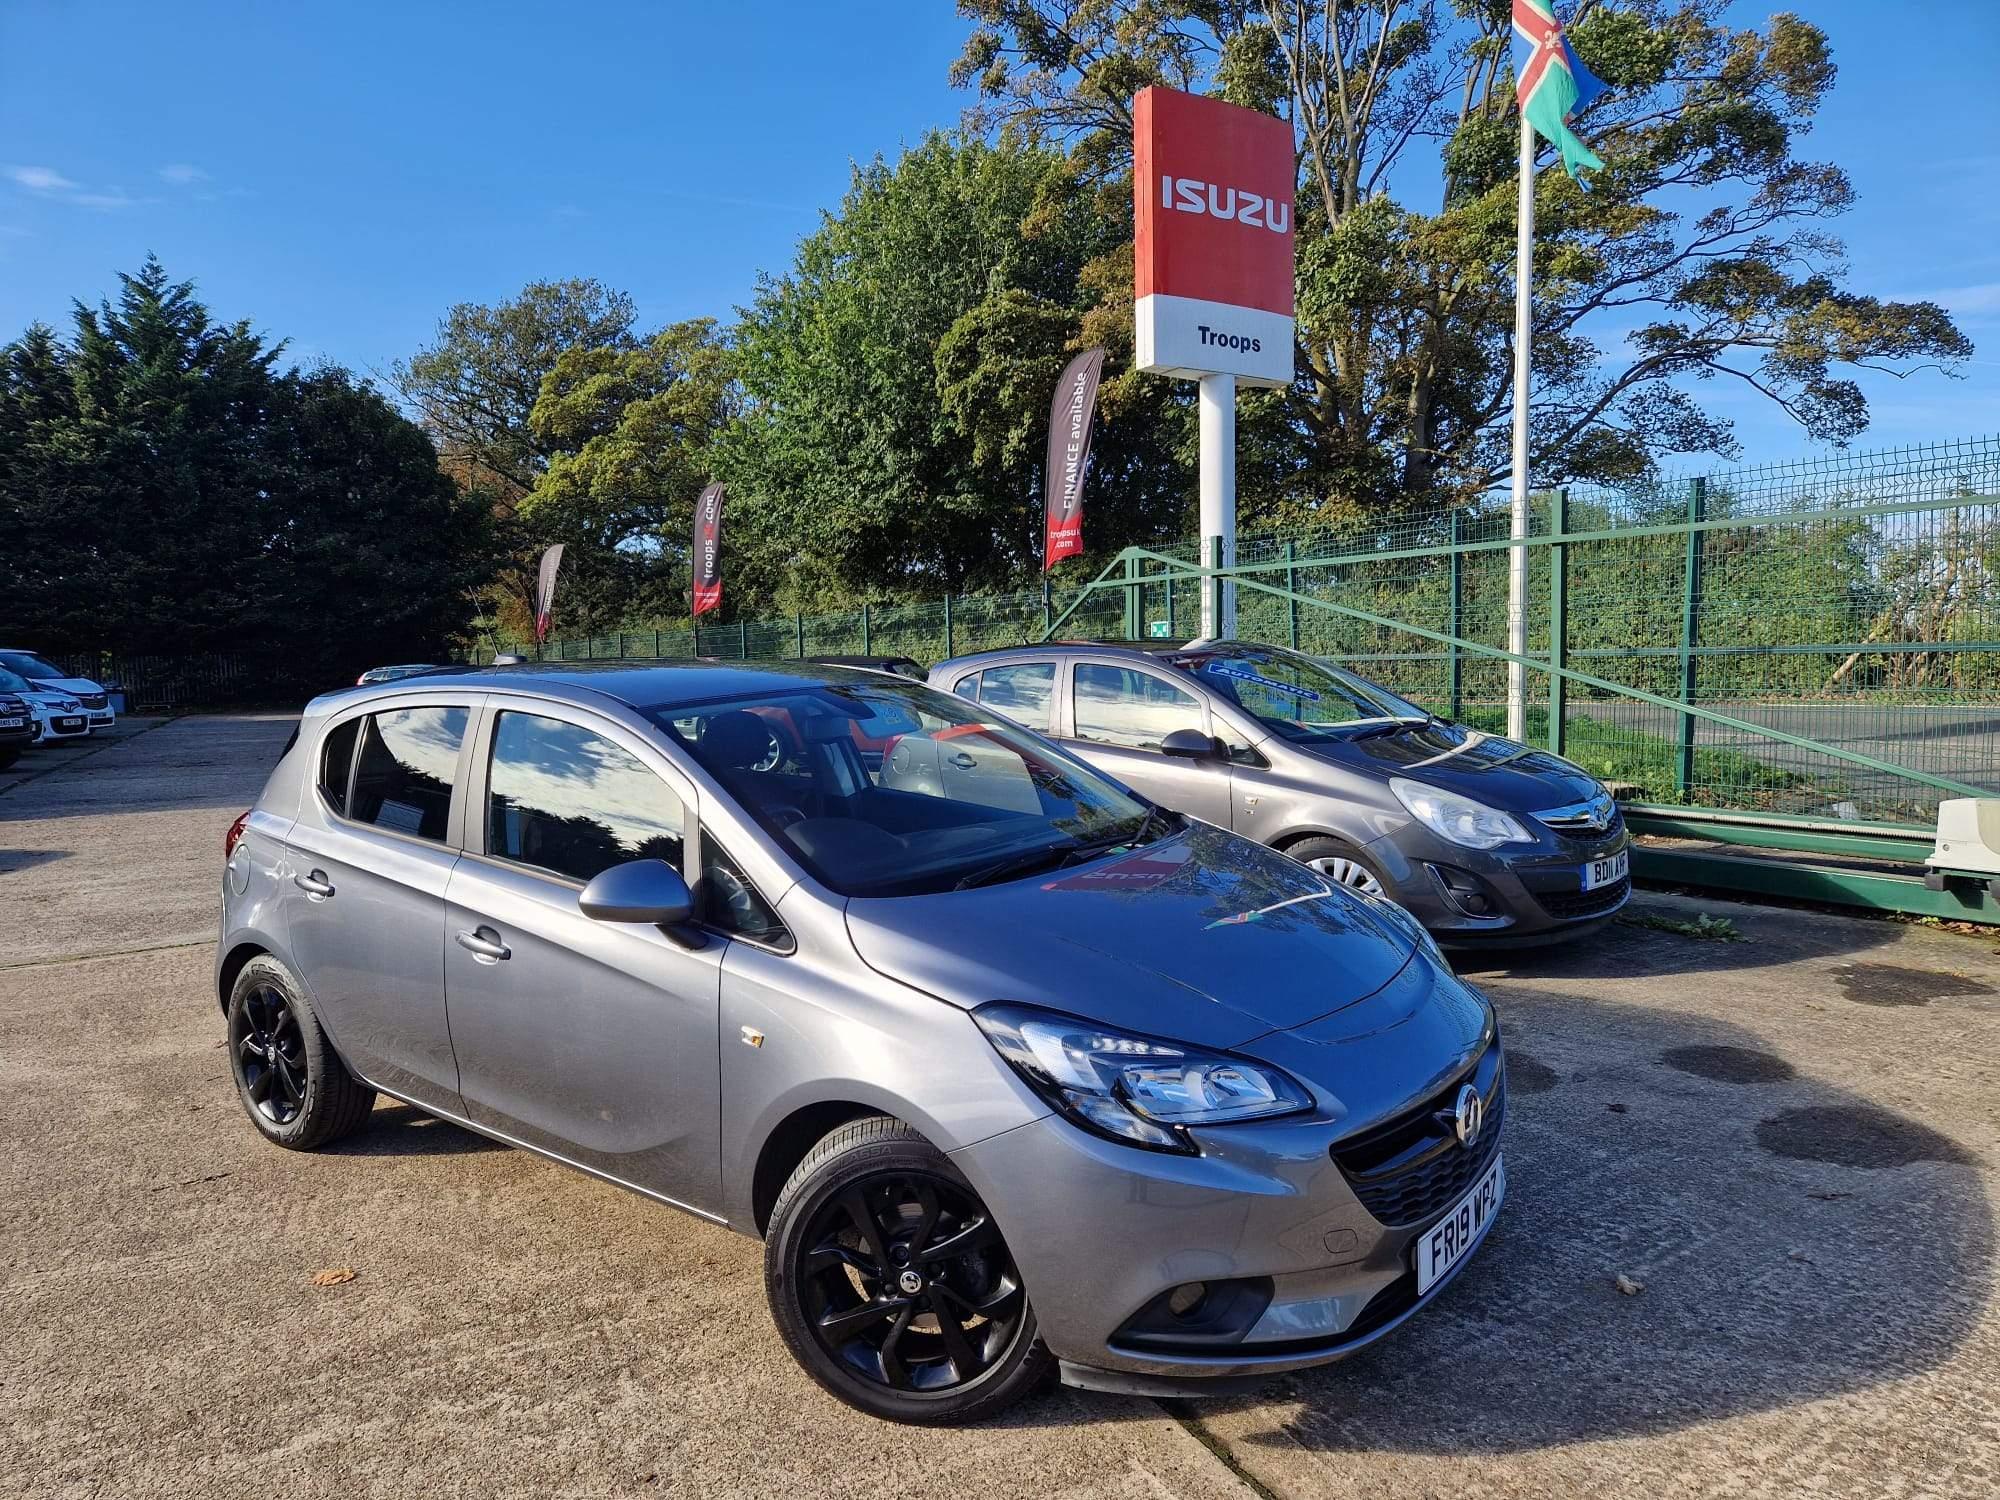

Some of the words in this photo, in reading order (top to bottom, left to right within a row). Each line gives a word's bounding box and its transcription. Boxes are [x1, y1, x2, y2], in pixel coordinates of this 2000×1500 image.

[1162, 175, 1288, 234] ISUZU
[1197, 325, 1261, 354] Troops
[1070, 372, 1086, 439] available
[1063, 443, 1079, 509] FINANCE
[1215, 667, 1314, 698] AUTOMATIC
[1431, 1204, 1470, 1278] FR19
